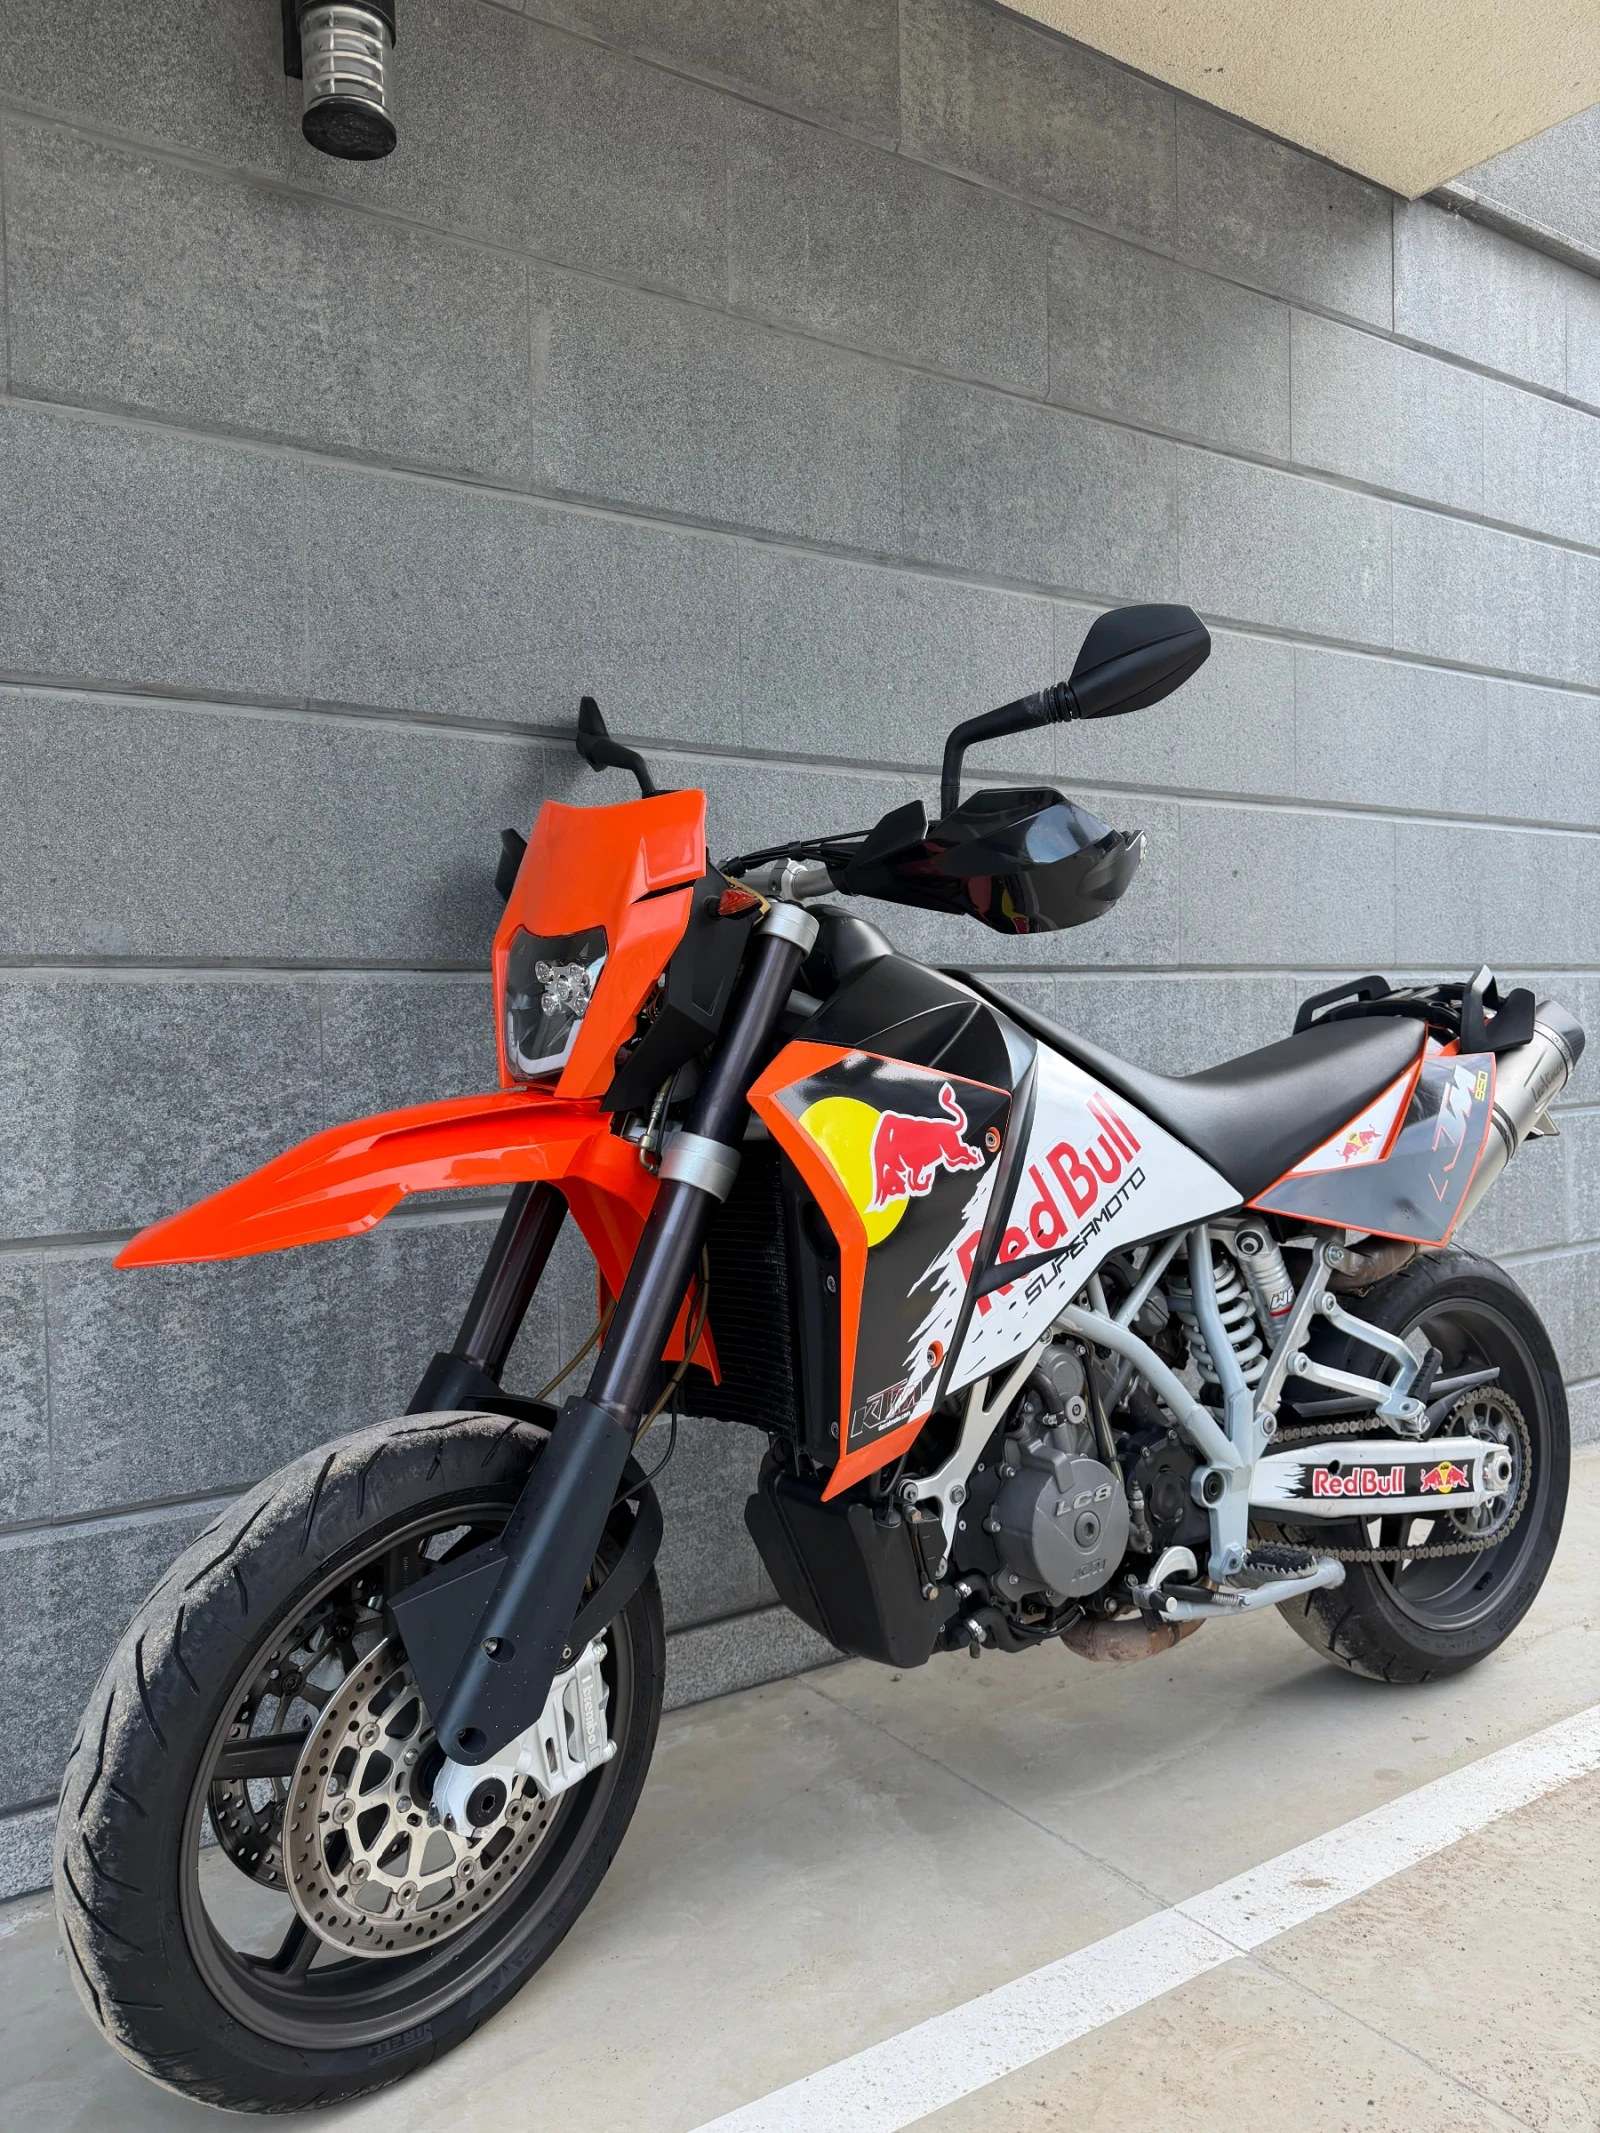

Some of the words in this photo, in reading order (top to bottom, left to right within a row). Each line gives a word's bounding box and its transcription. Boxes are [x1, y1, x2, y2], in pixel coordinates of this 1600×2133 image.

[1474, 1070, 1489, 1101] 950
[1045, 1091, 1142, 1220] Bull
[1025, 1167, 1146, 1306] SUPERMOTO
[850, 1378, 922, 1438] KTM
[1055, 1483, 1112, 1516] LC8
[1314, 1468, 1360, 1495] Red
[1361, 1467, 1404, 1494] Bull
[582, 1684, 597, 1745] brembo
